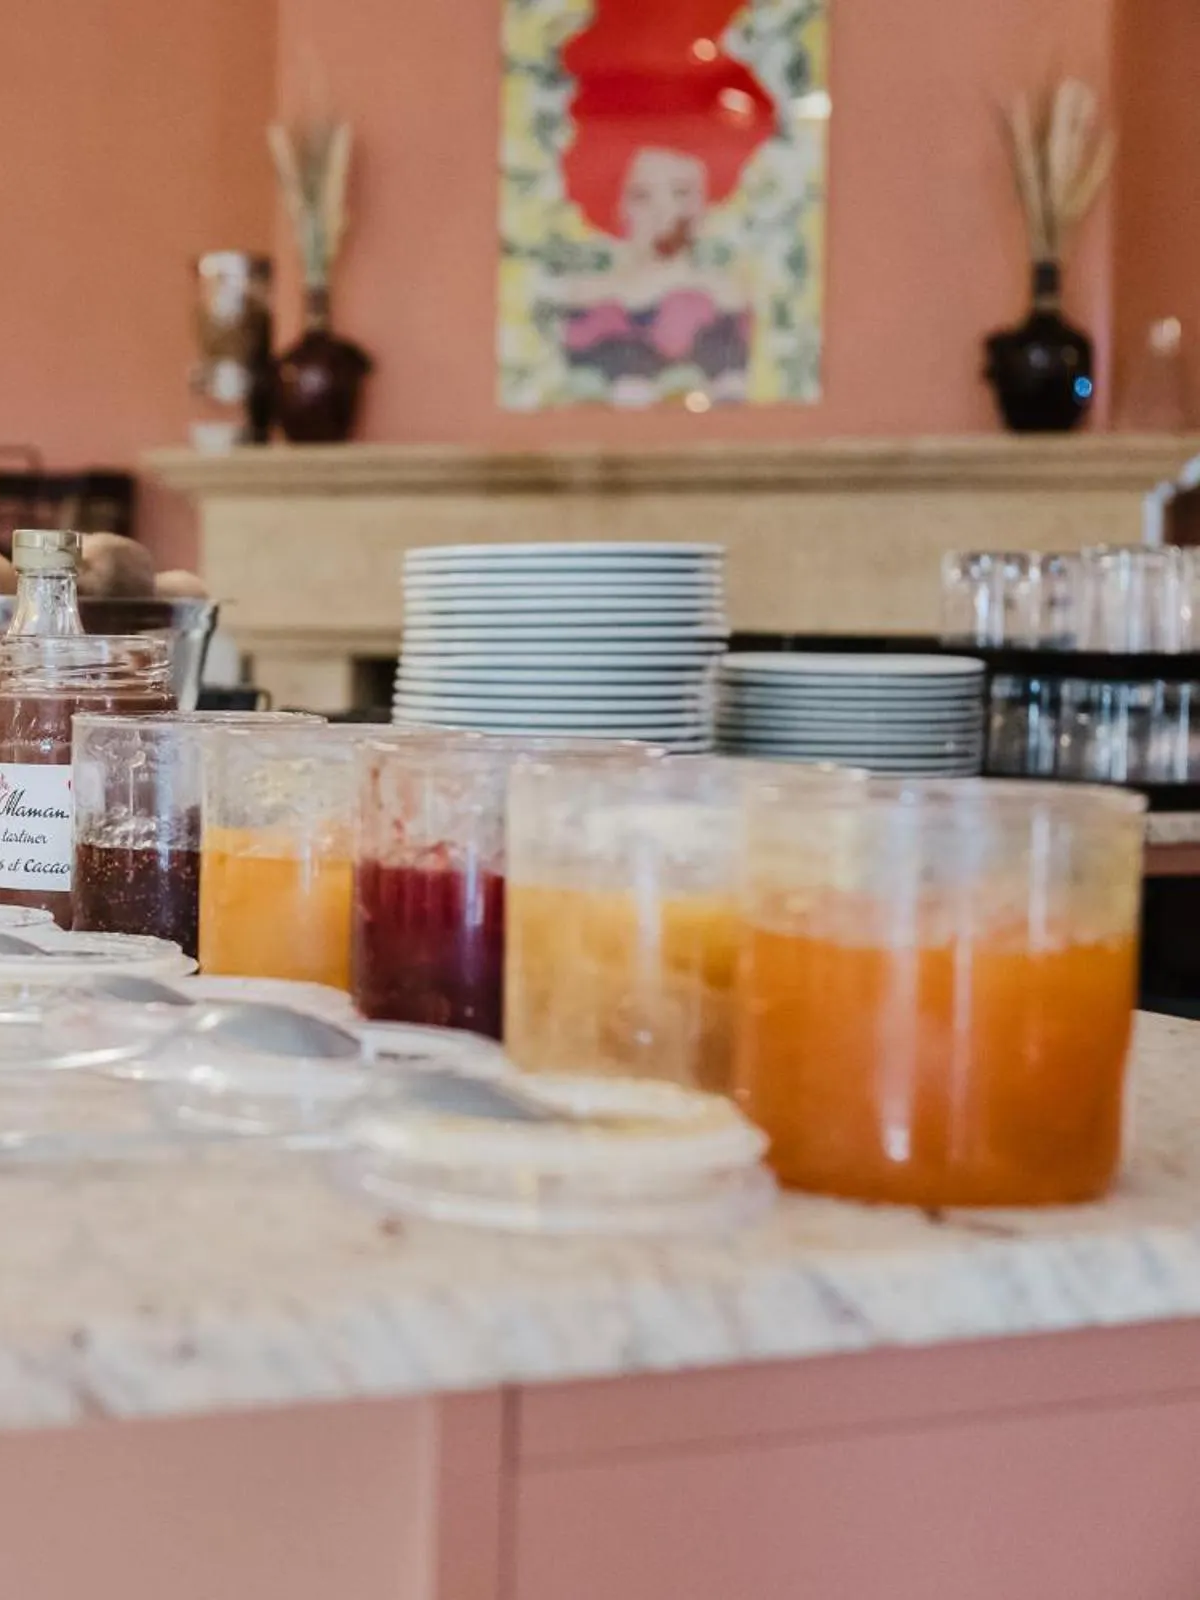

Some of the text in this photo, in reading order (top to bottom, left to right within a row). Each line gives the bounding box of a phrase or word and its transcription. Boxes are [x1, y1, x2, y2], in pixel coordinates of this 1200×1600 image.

[1, 827, 47, 844] tartiner
[7, 857, 21, 872] et
[23, 858, 70, 875] Cacao
